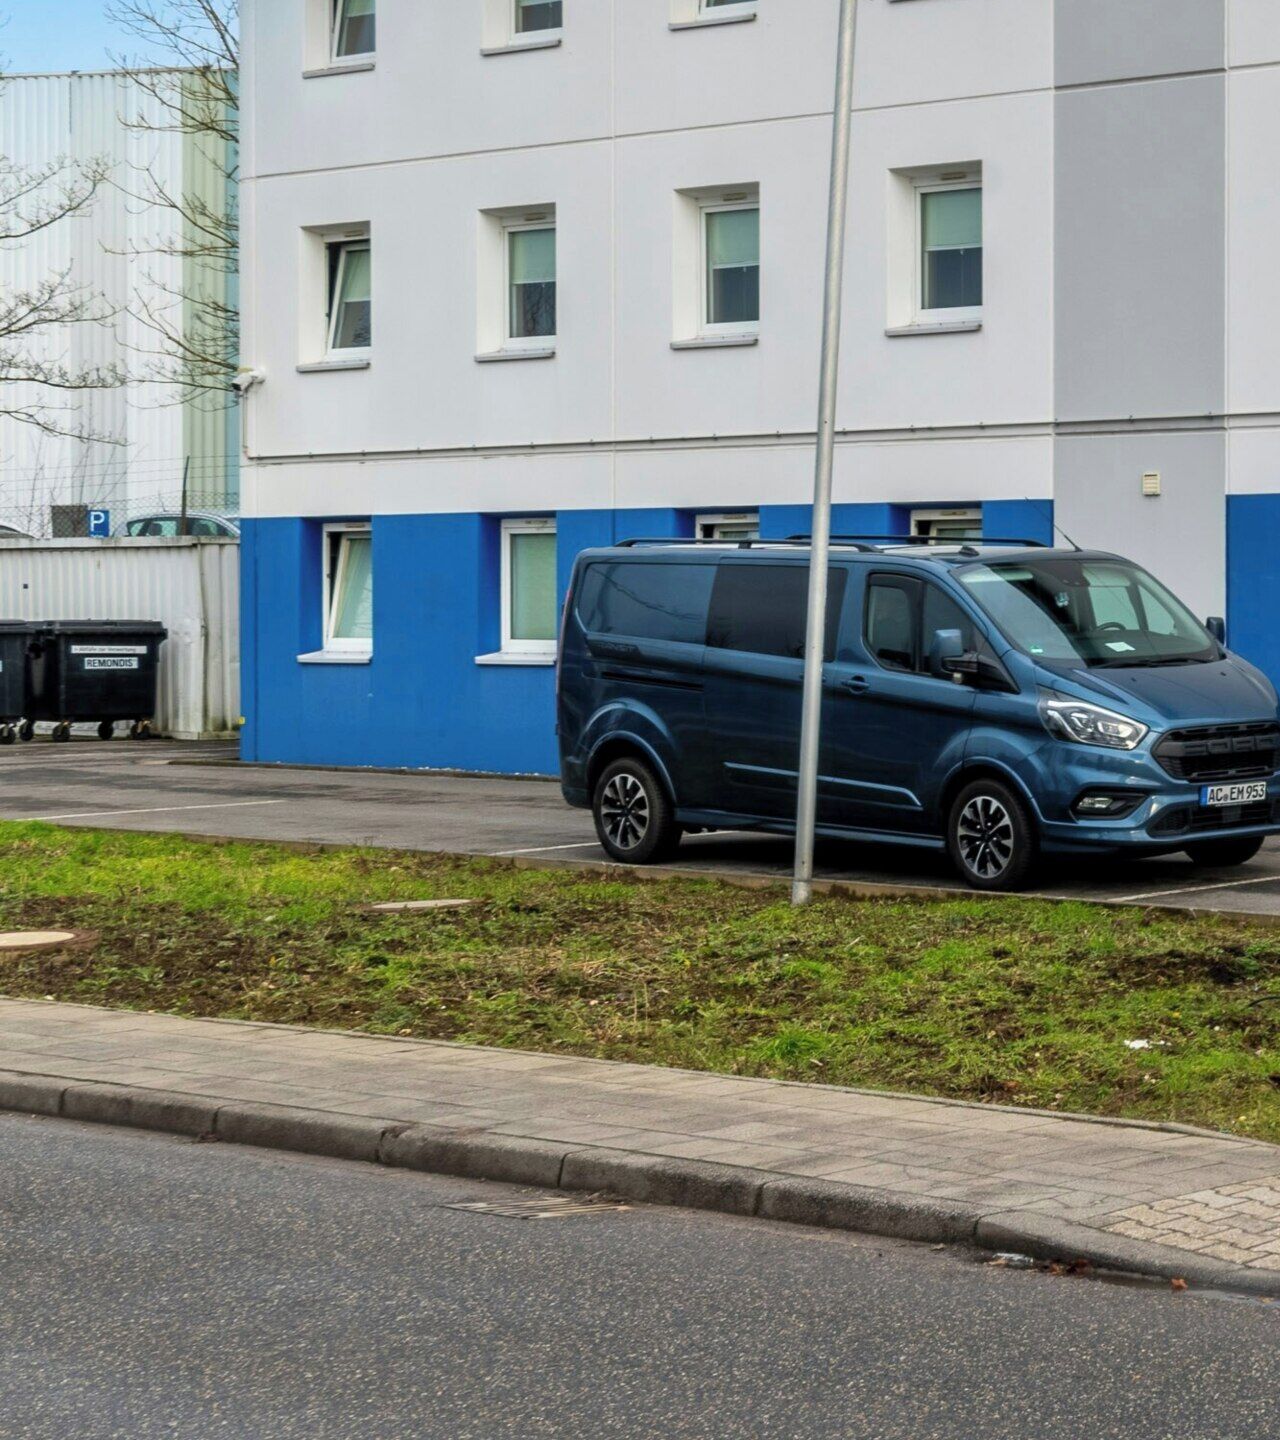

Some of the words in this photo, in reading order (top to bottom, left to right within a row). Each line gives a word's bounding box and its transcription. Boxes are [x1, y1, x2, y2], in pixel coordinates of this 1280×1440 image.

[90, 511, 105, 532] P
[86, 658, 134, 667] REMONDIS
[1208, 787, 1223, 802] AC
[1230, 786, 1245, 801] EM
[1246, 784, 1265, 799] 953
